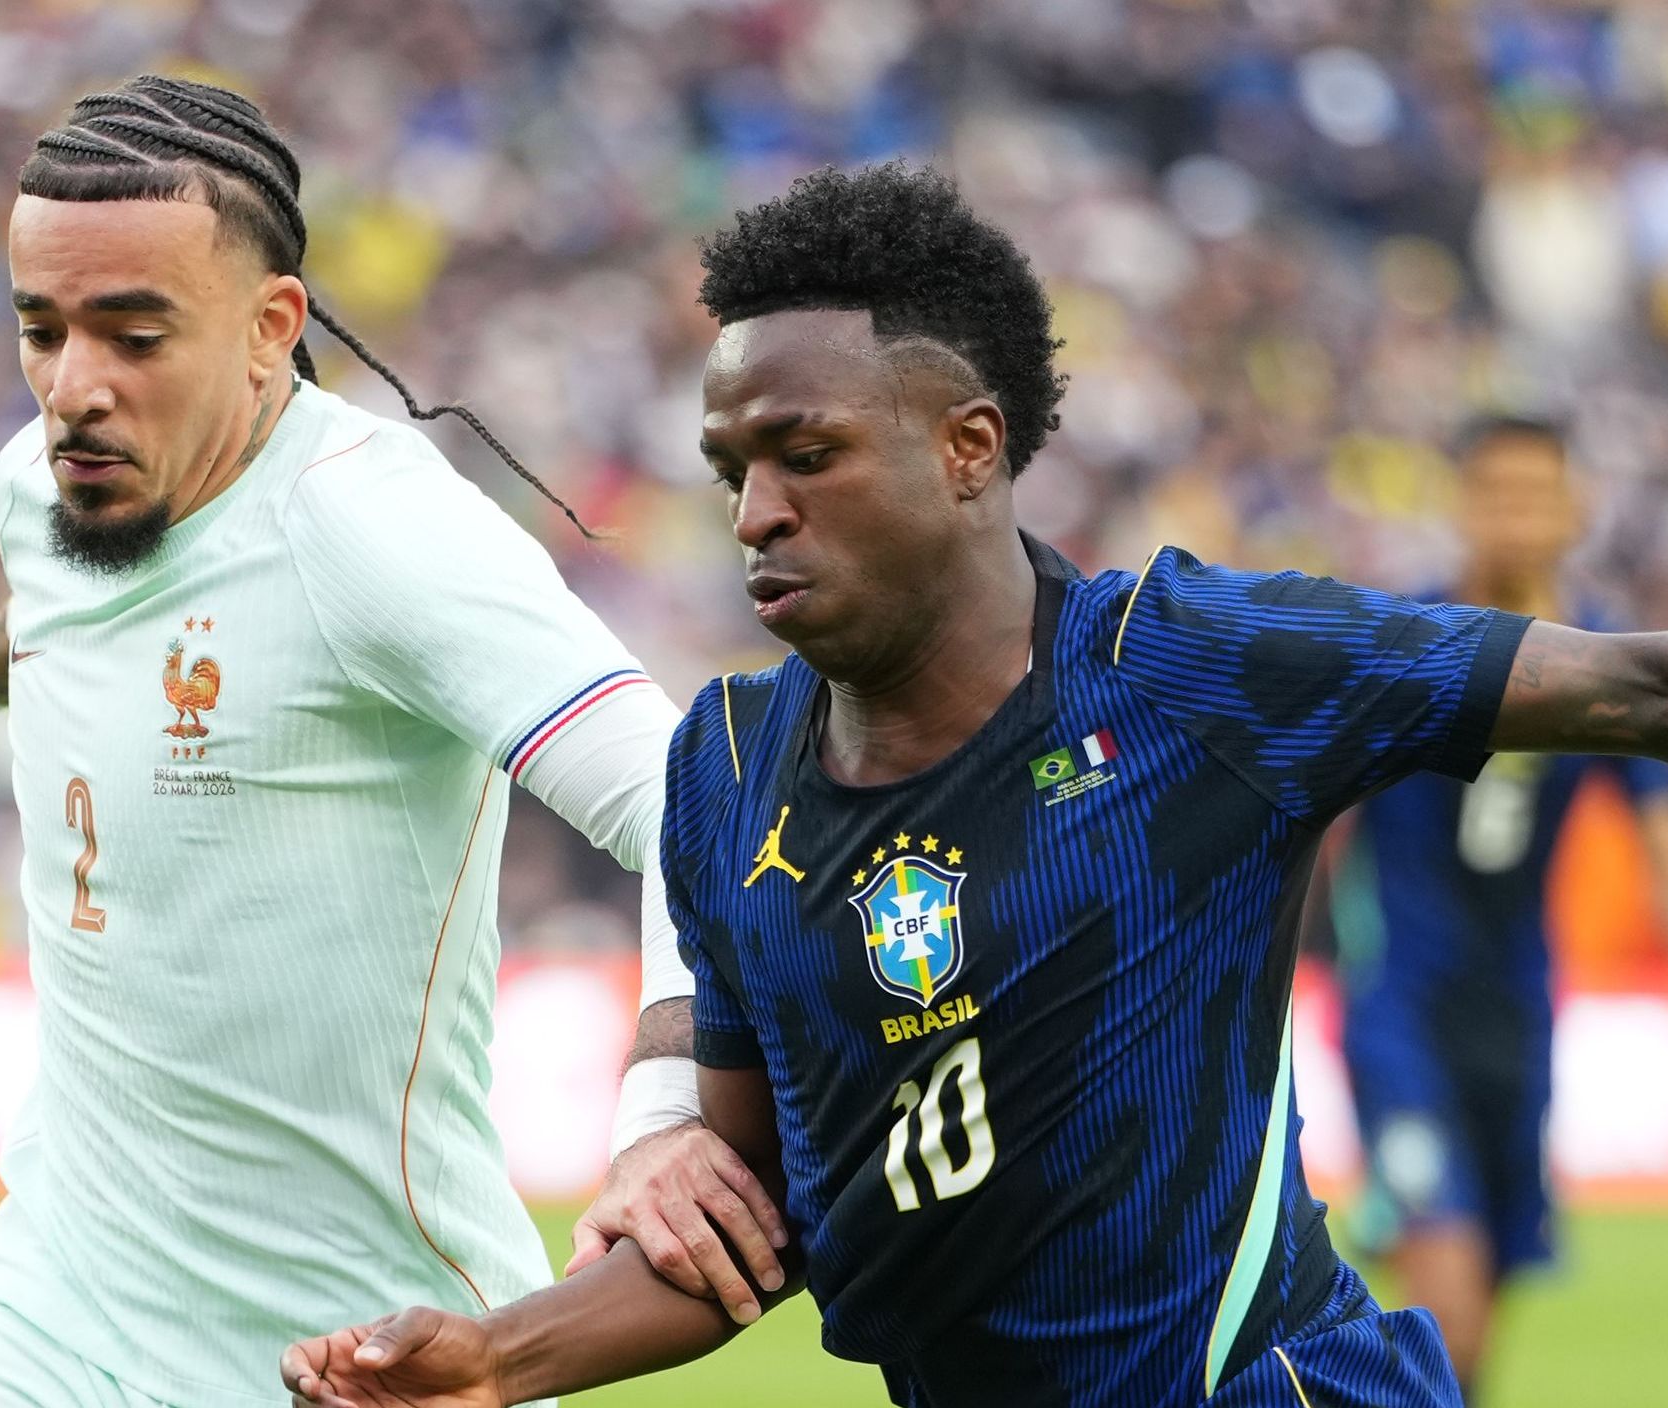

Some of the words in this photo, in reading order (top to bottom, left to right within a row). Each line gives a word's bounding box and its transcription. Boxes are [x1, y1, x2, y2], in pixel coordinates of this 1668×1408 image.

[153, 782, 167, 796] 26
[171, 784, 198, 796] MARS
[202, 782, 236, 796] 2026
[154, 767, 182, 782] BRÉSIL
[193, 770, 231, 783] FRANCE
[65, 777, 107, 933] 2
[894, 915, 929, 936] CBF
[880, 994, 980, 1044] BRASIL
[884, 1038, 996, 1212] 10
